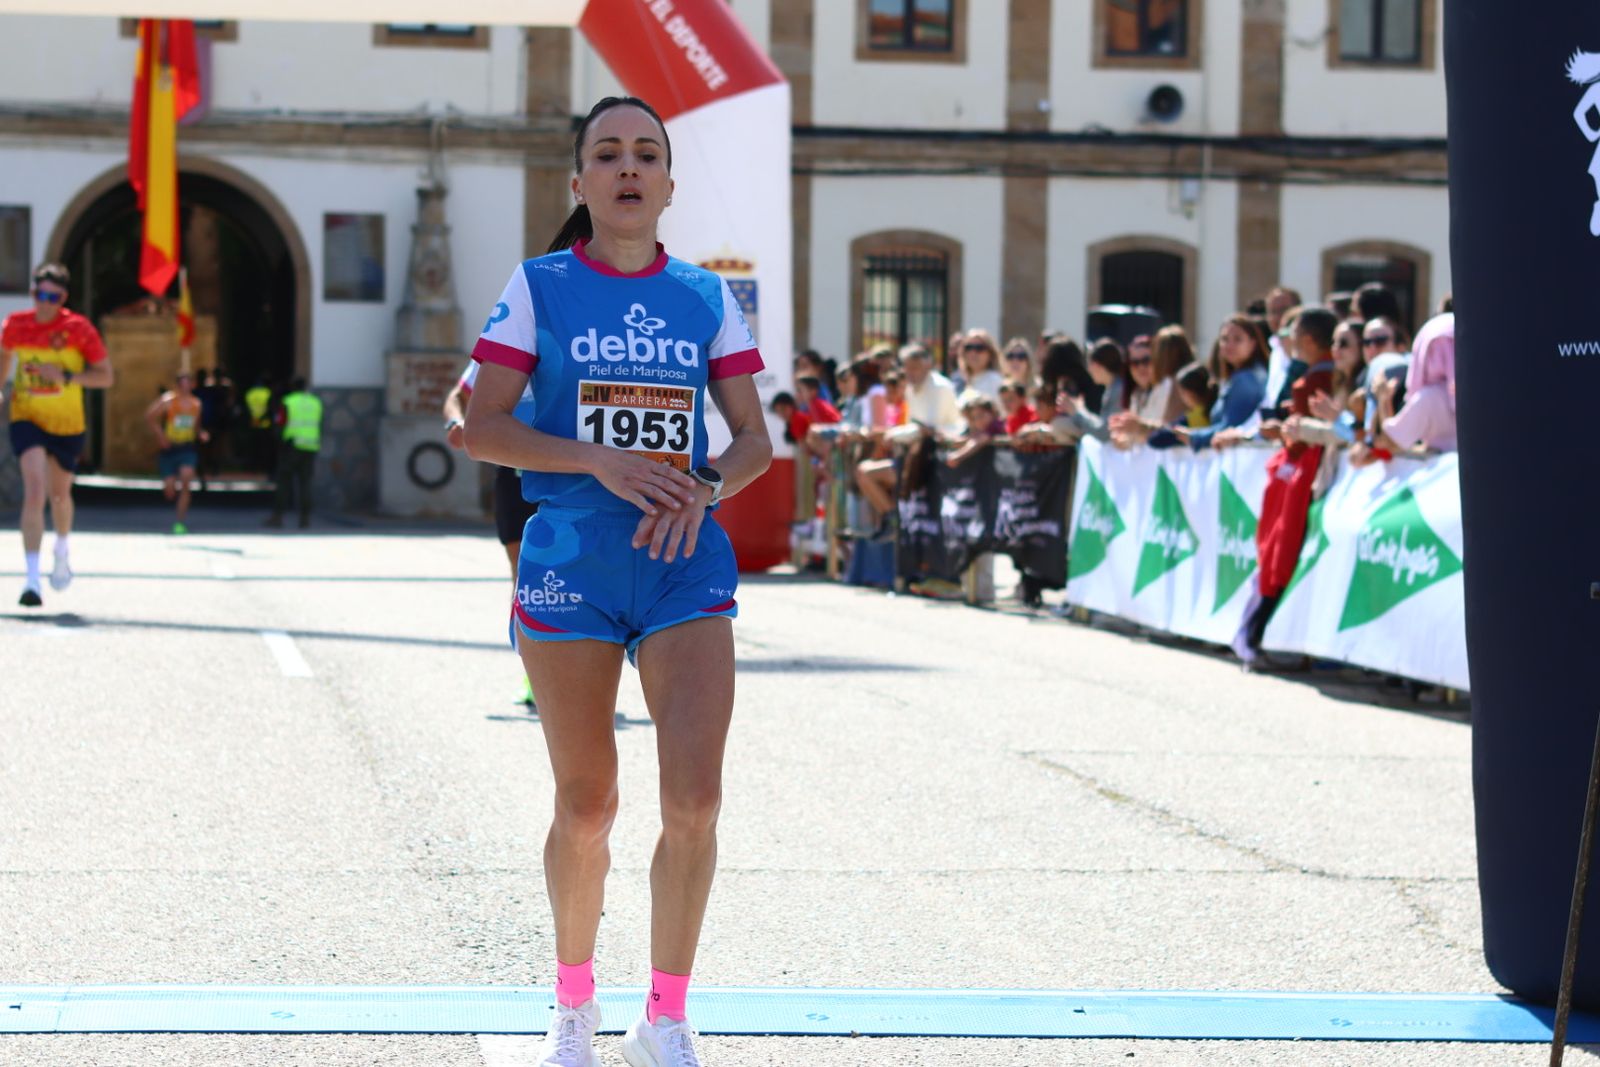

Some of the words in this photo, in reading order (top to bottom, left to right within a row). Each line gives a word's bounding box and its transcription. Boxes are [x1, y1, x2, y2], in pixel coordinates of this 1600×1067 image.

[663, 13, 729, 92] DEPORTE
[570, 327, 699, 368] debra
[588, 364, 611, 377] Piel
[614, 364, 630, 376] de
[632, 364, 688, 380] Mariposa
[613, 394, 668, 407] CARRERA
[584, 407, 690, 452] 1953
[517, 584, 583, 606] debra
